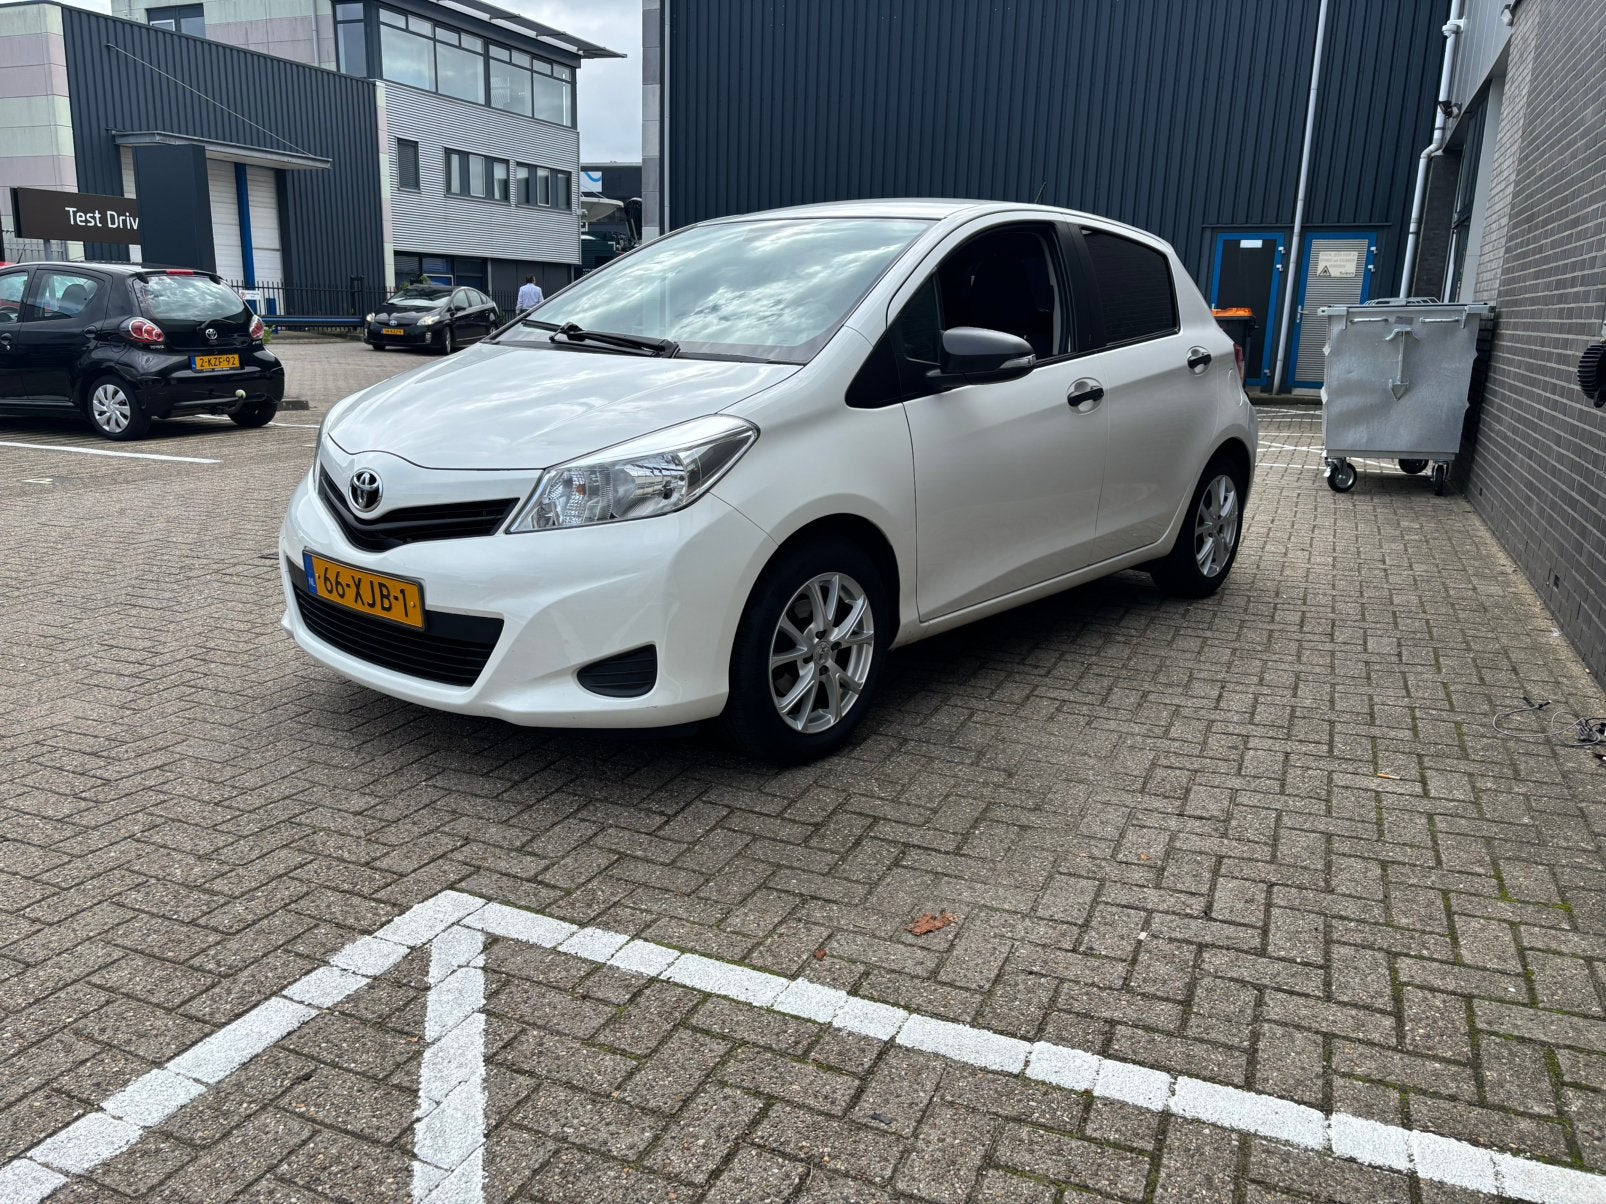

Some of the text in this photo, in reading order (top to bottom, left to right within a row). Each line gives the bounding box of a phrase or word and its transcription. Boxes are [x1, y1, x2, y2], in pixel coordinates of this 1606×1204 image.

[65, 207, 102, 227] Test
[199, 356, 236, 367] 2-KZF-92
[323, 566, 409, 618] 66-XJB-1
